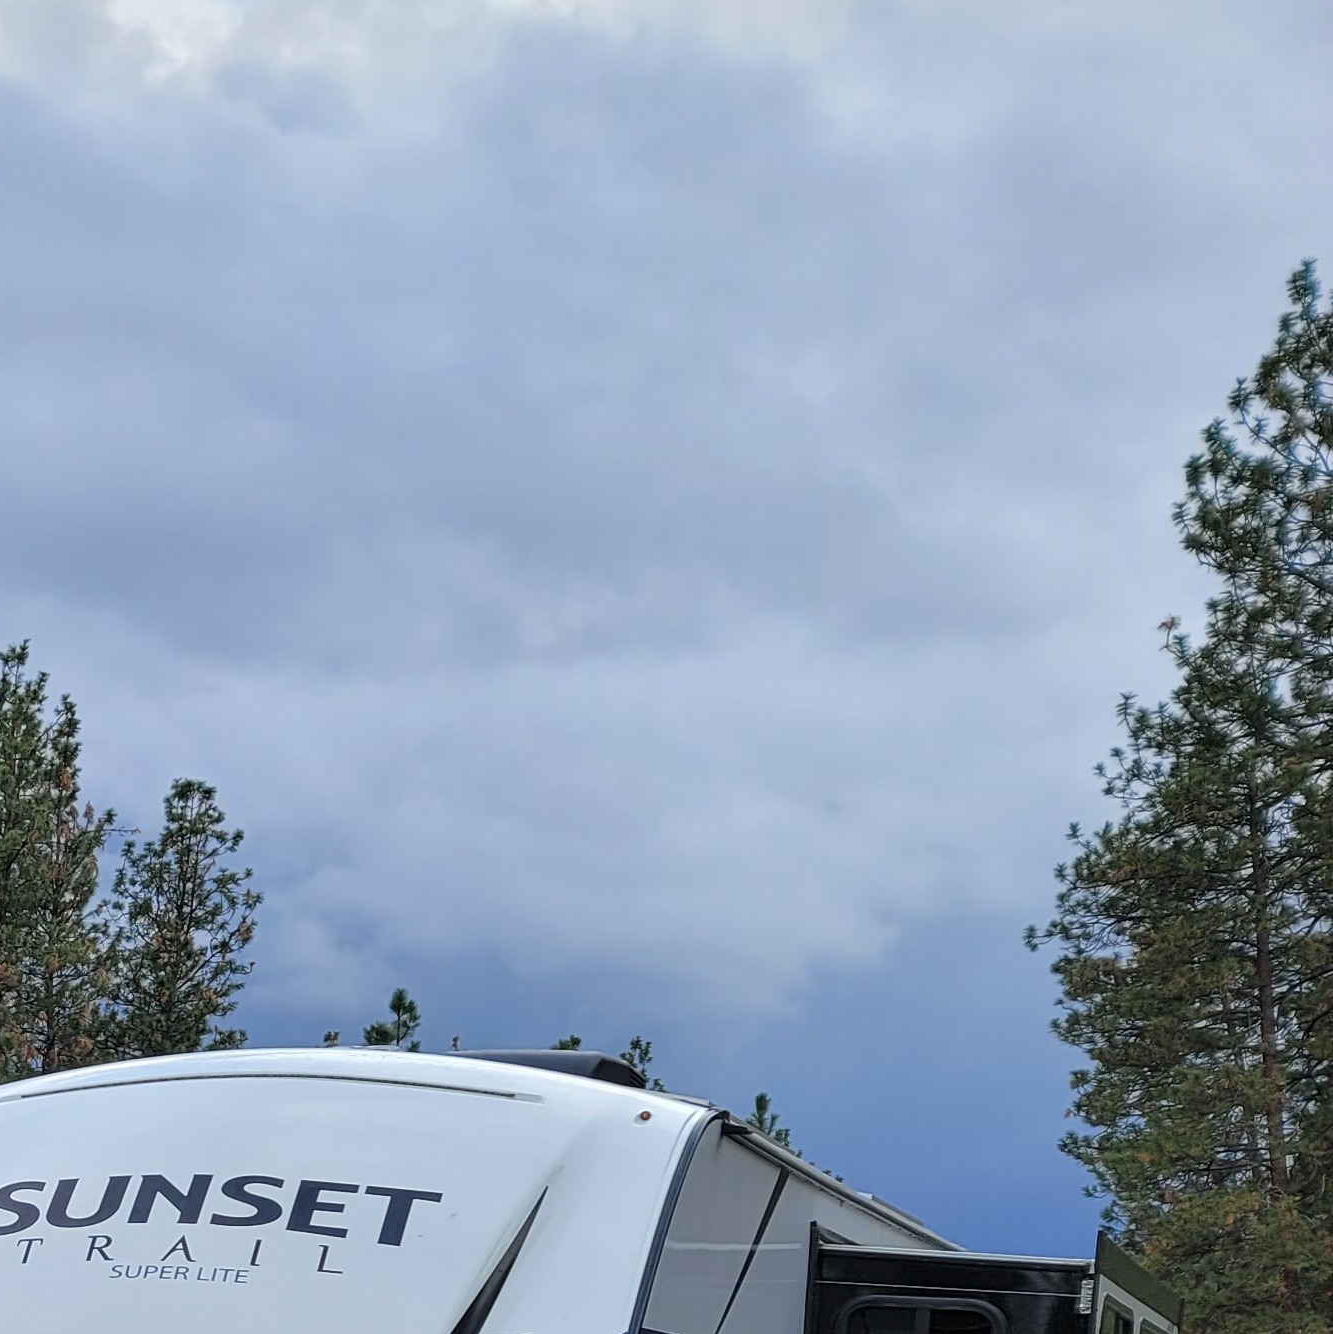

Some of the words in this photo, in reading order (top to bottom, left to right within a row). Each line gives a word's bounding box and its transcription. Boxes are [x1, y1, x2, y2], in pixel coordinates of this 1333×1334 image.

[16, 1235, 344, 1275] TRAIL
[109, 1264, 190, 1281] SUPER
[196, 1266, 250, 1284] LITE
